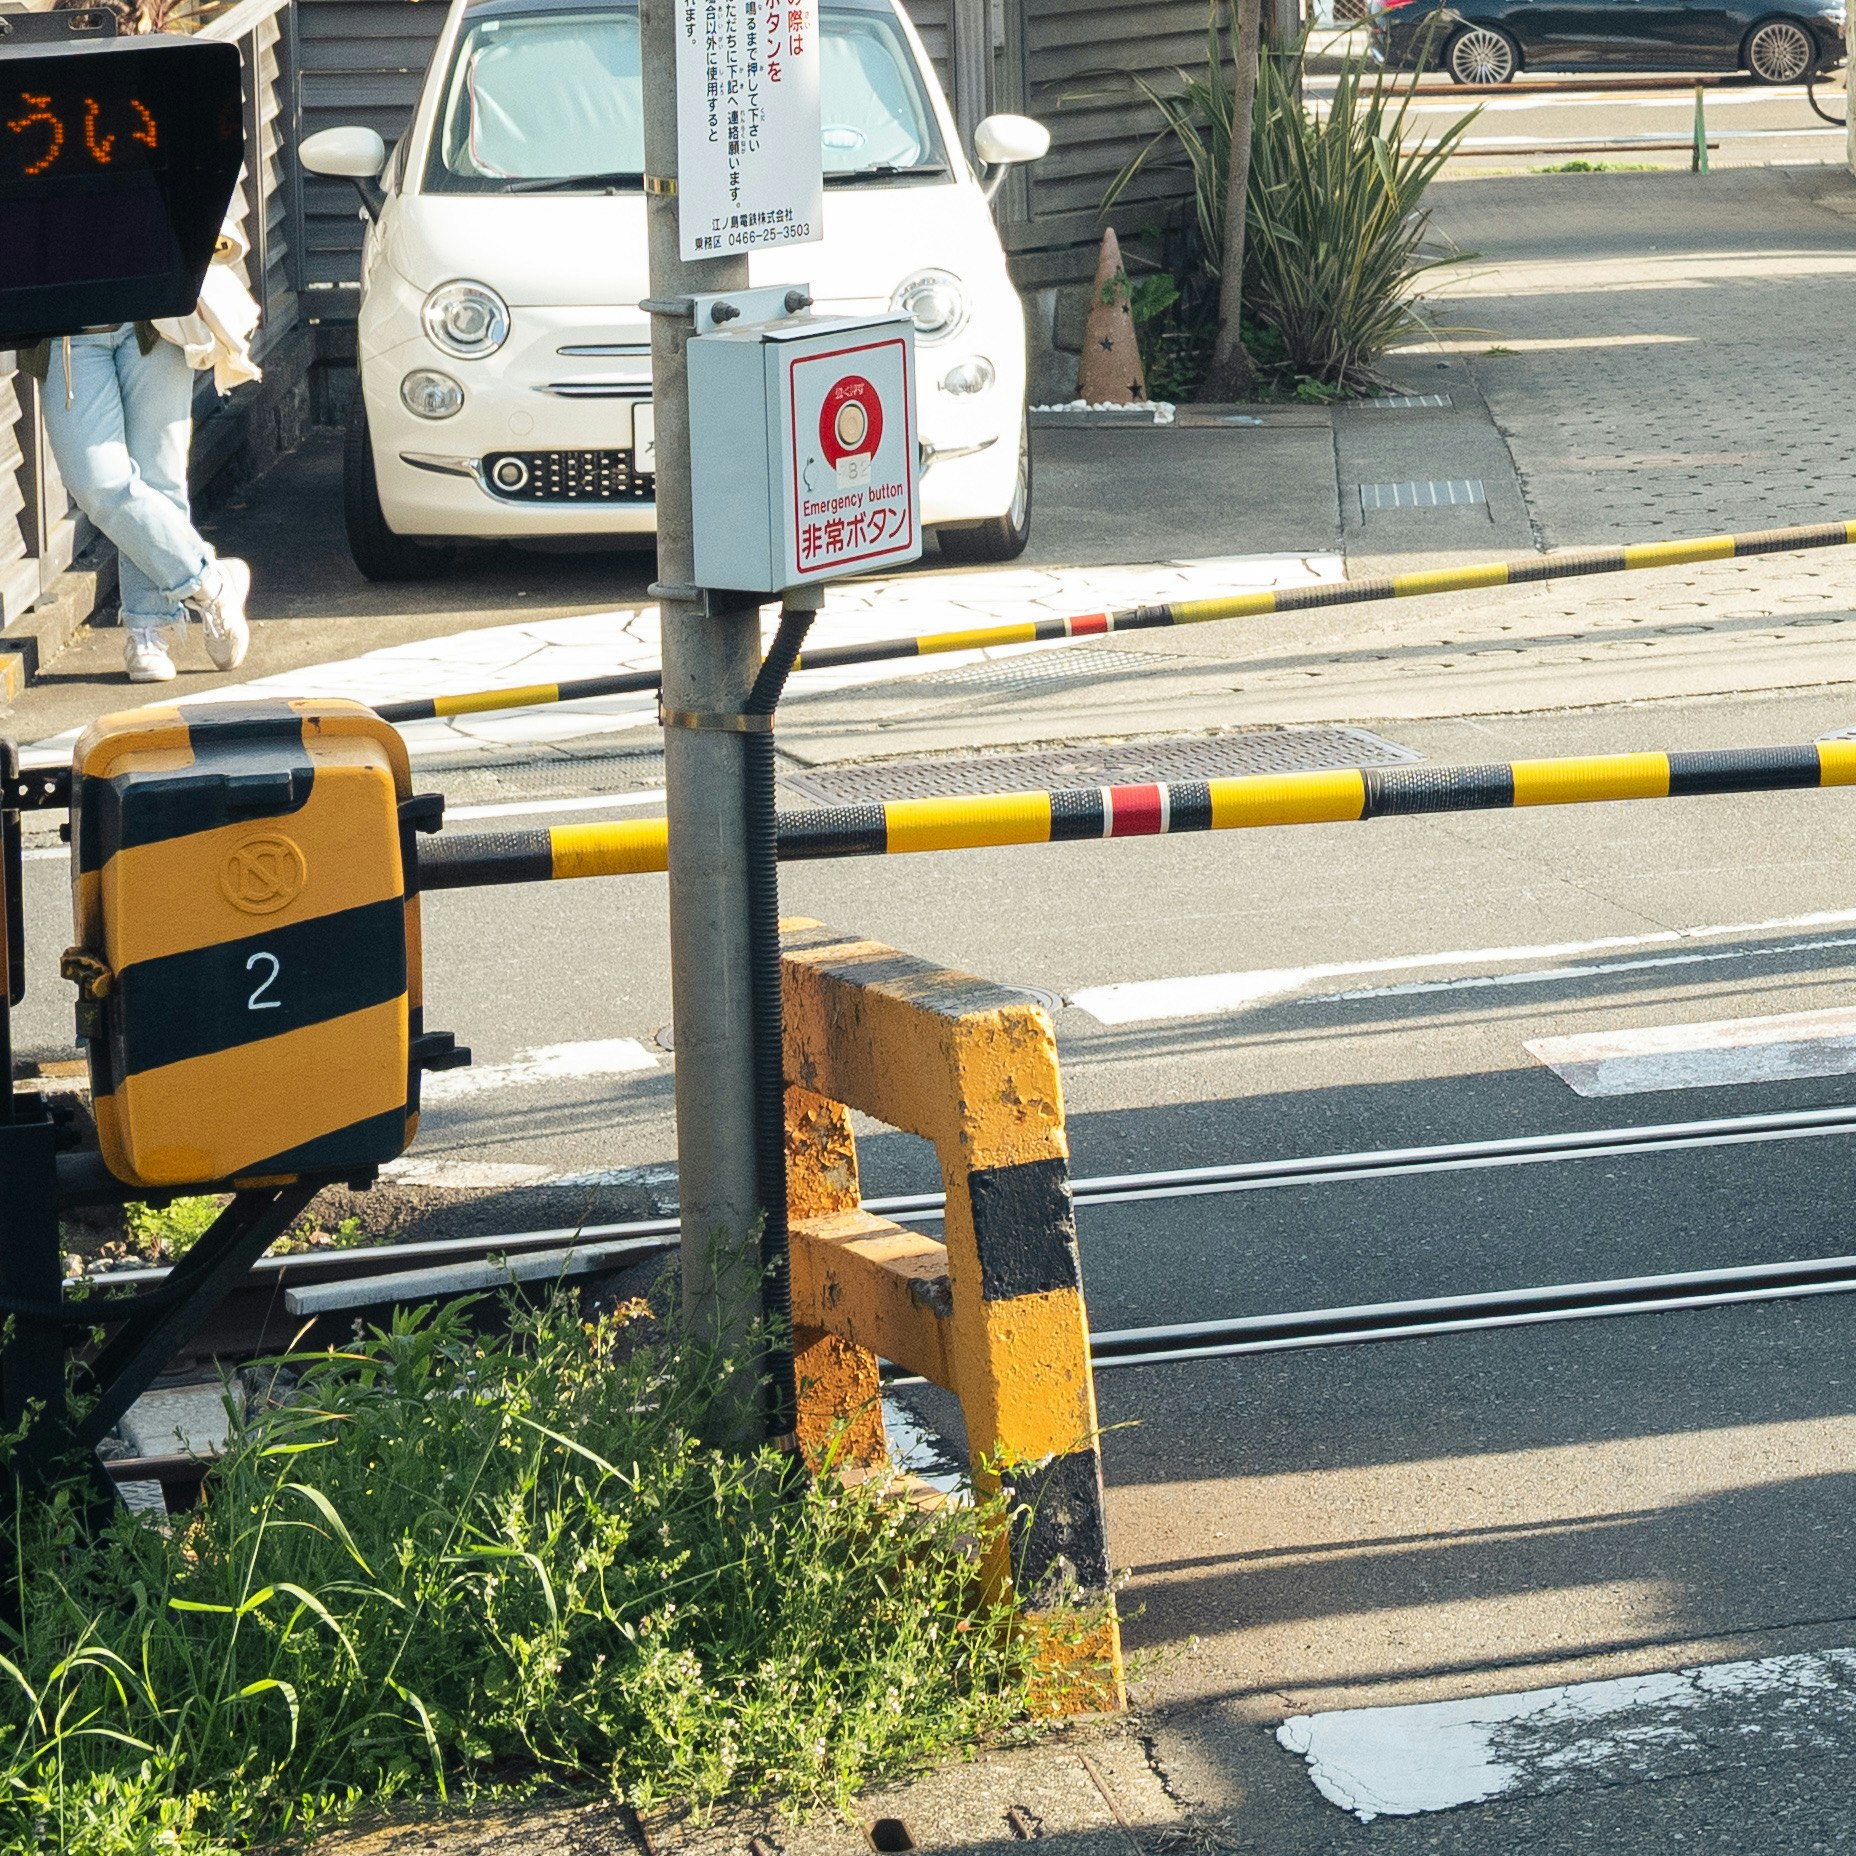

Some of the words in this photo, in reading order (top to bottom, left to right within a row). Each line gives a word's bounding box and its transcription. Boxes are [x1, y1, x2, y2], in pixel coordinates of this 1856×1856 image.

[728, 222, 811, 247] 0466-25-3503
[803, 493, 864, 518] Emergency
[868, 483, 904, 504] button
[802, 507, 907, 560] 非常ボタン
[245, 951, 282, 1010] 2
